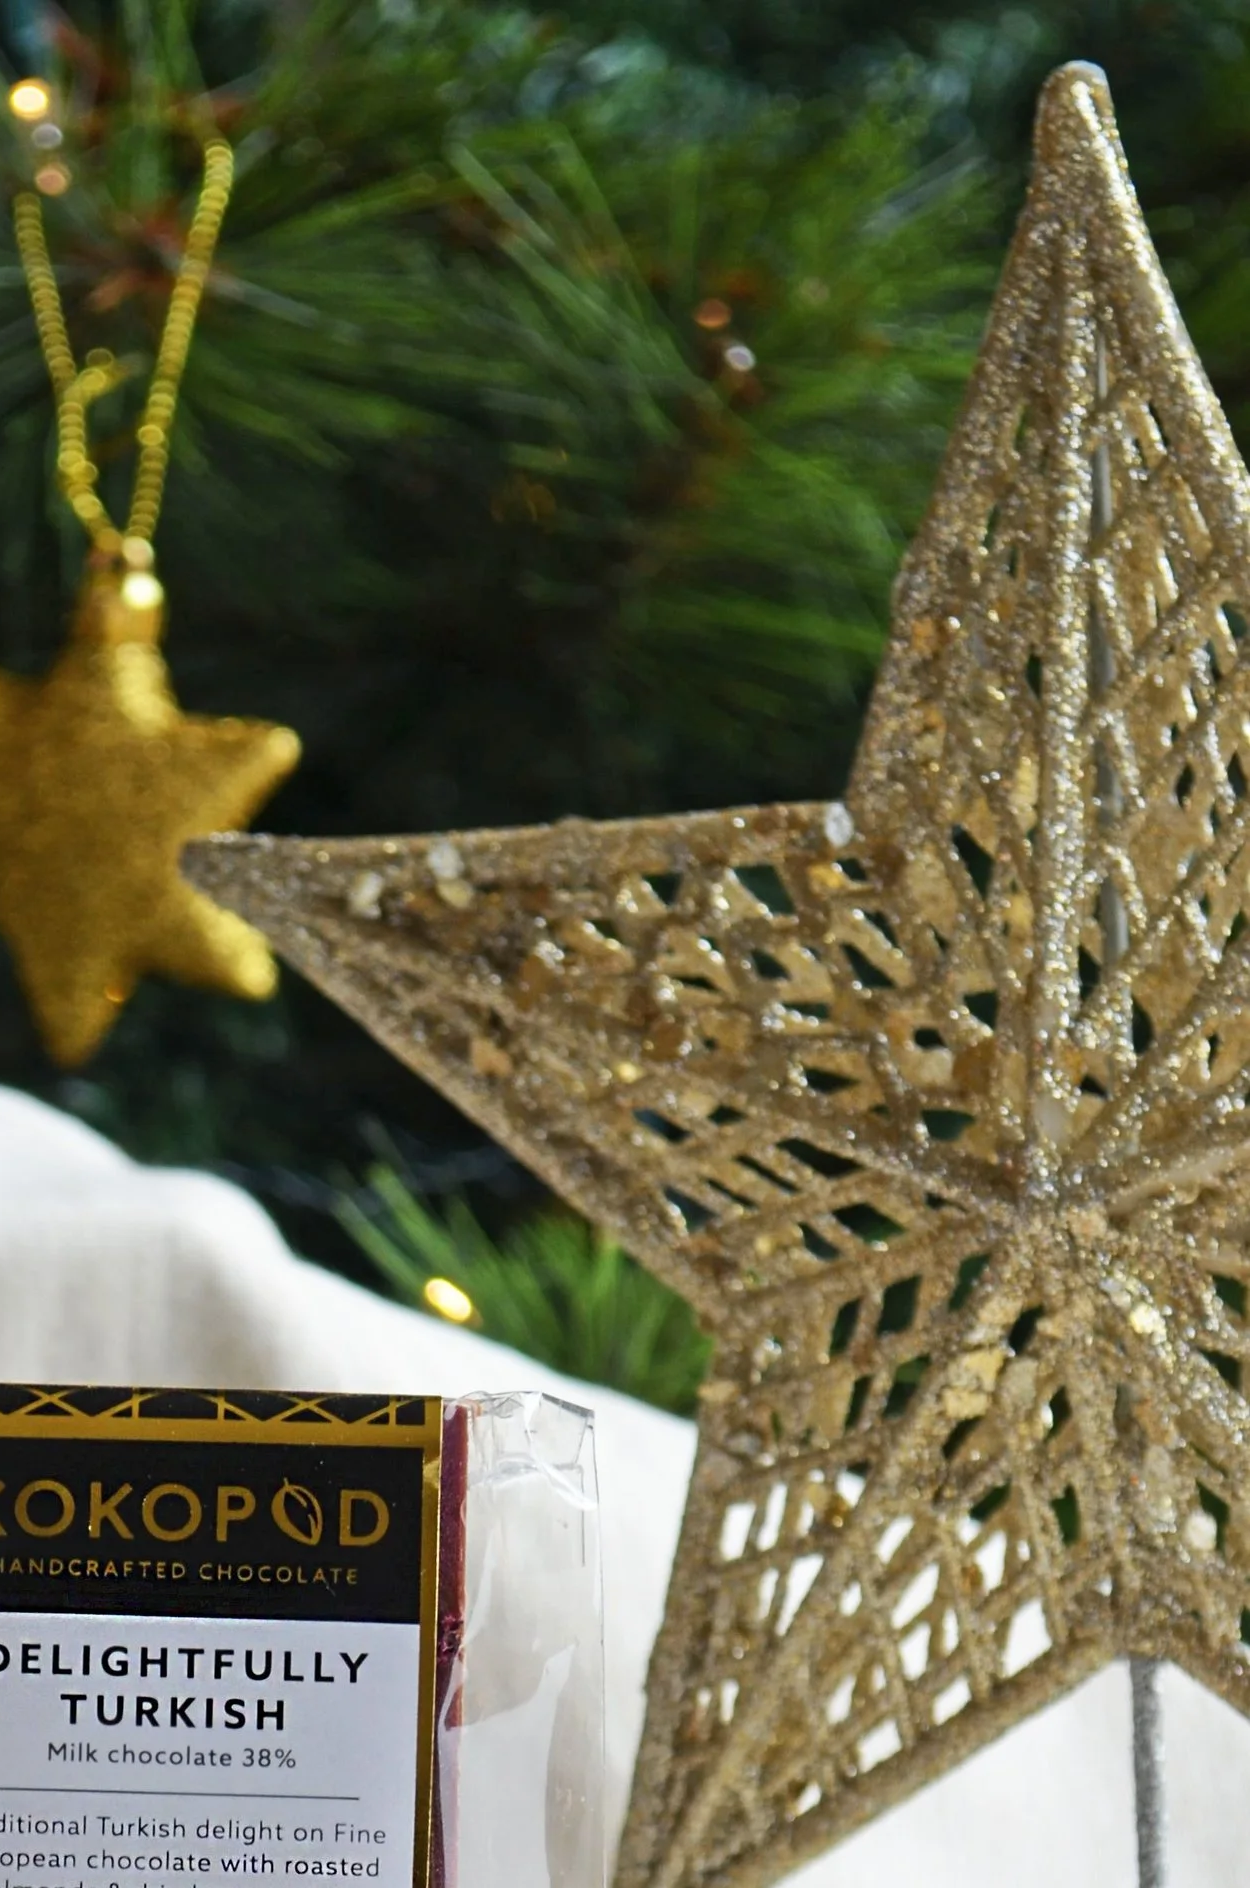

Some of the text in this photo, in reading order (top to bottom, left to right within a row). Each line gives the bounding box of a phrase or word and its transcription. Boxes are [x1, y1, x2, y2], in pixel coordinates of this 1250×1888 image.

[199, 1562, 360, 1585] CHOCOLATE
[60, 1693, 286, 1731] TURKISH
[47, 1742, 297, 1770] Milk chocolate 38%
[96, 1815, 187, 1839] Turkish
[195, 1818, 284, 1846] delight
[293, 1826, 324, 1844] on
[333, 1823, 388, 1845] Fine
[86, 1848, 212, 1875] chocolate
[220, 1852, 275, 1876] with
[284, 1855, 381, 1879] roasted
